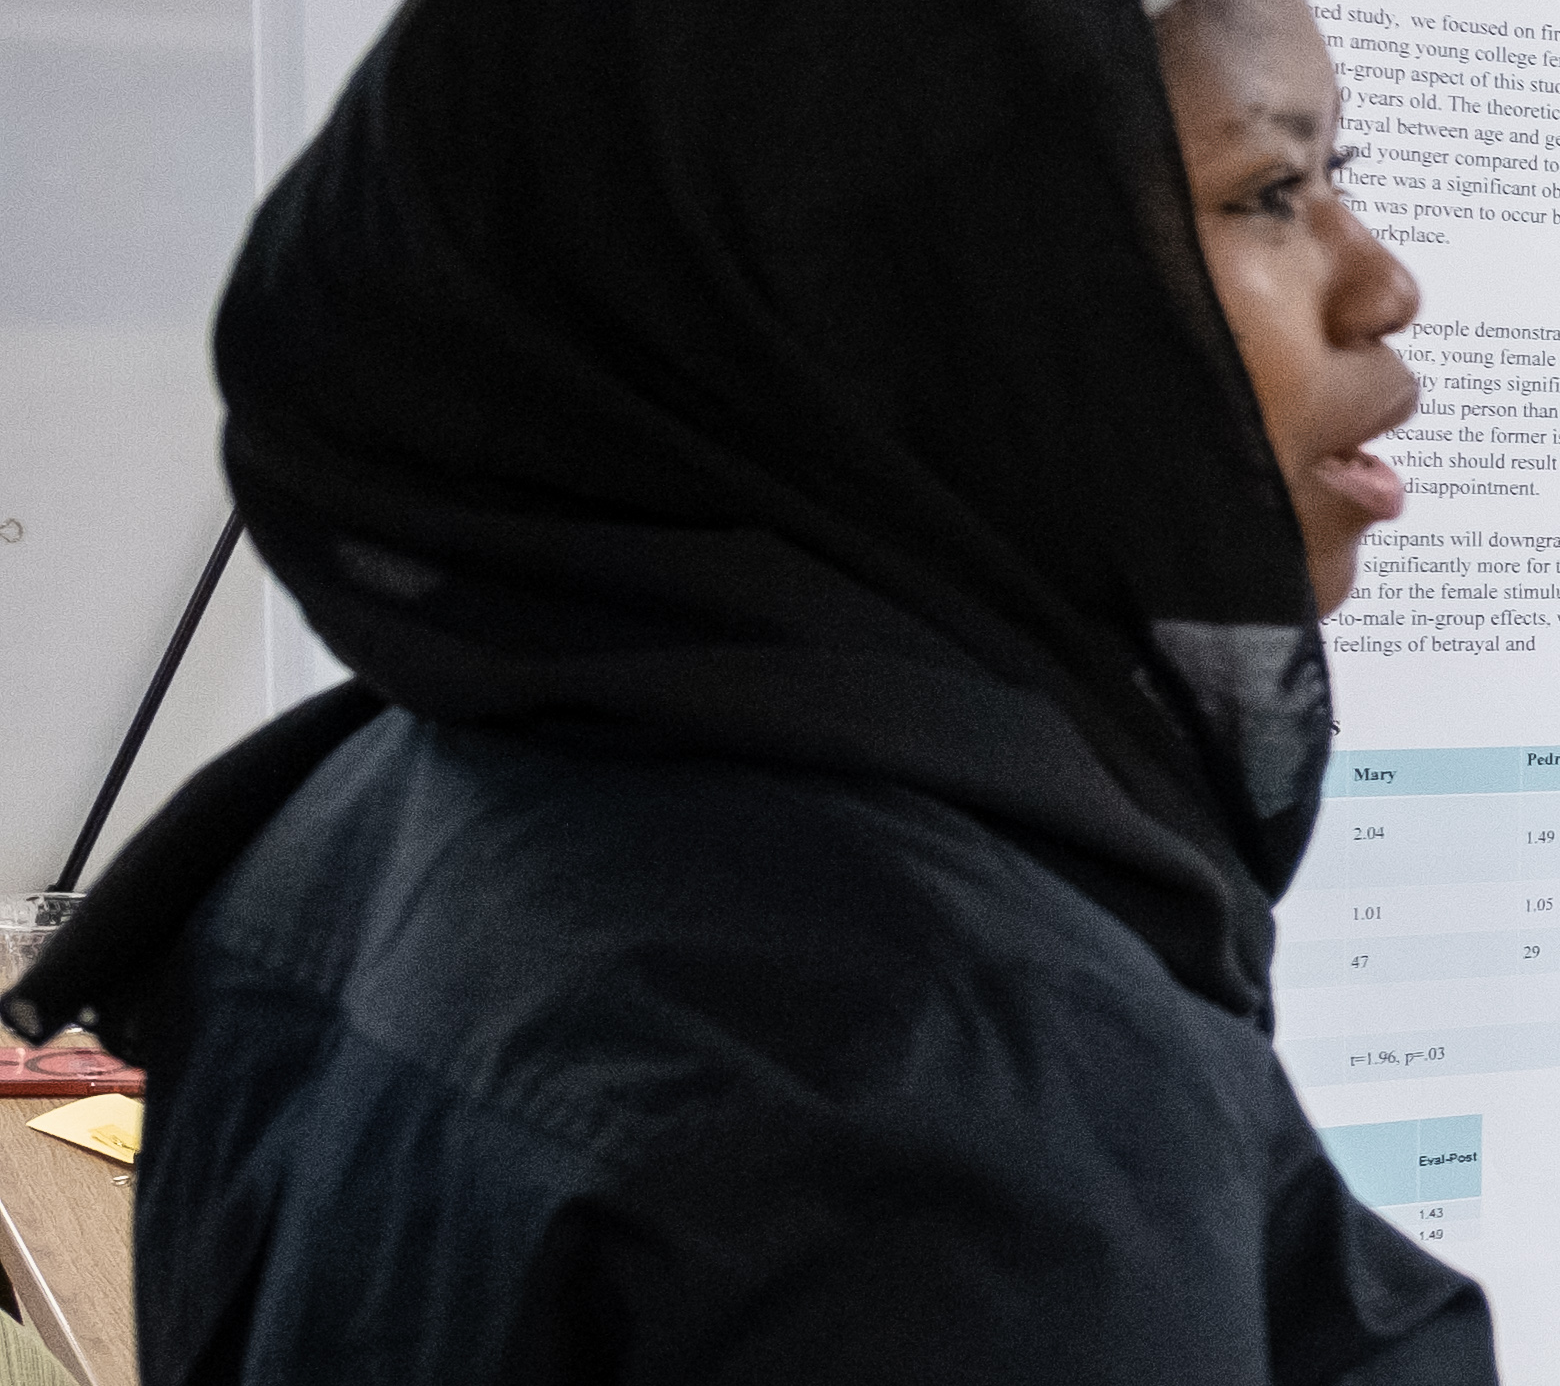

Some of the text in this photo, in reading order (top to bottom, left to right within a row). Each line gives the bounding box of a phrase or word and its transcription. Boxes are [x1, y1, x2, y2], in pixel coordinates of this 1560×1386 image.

[1412, 320, 1471, 341] people
[1352, 766, 1398, 784] Mary
[1352, 825, 1386, 841] 2.04
[1525, 830, 1557, 845] 1.49
[1524, 898, 1555, 913] 1.05
[1352, 906, 1383, 922] 1.01
[1522, 944, 1542, 960] 29
[1350, 955, 1370, 970] 47
[1417, 1151, 1479, 1168] Eval-Post
[1418, 1208, 1445, 1220] 1.43
[1418, 1229, 1445, 1241] 1.49
